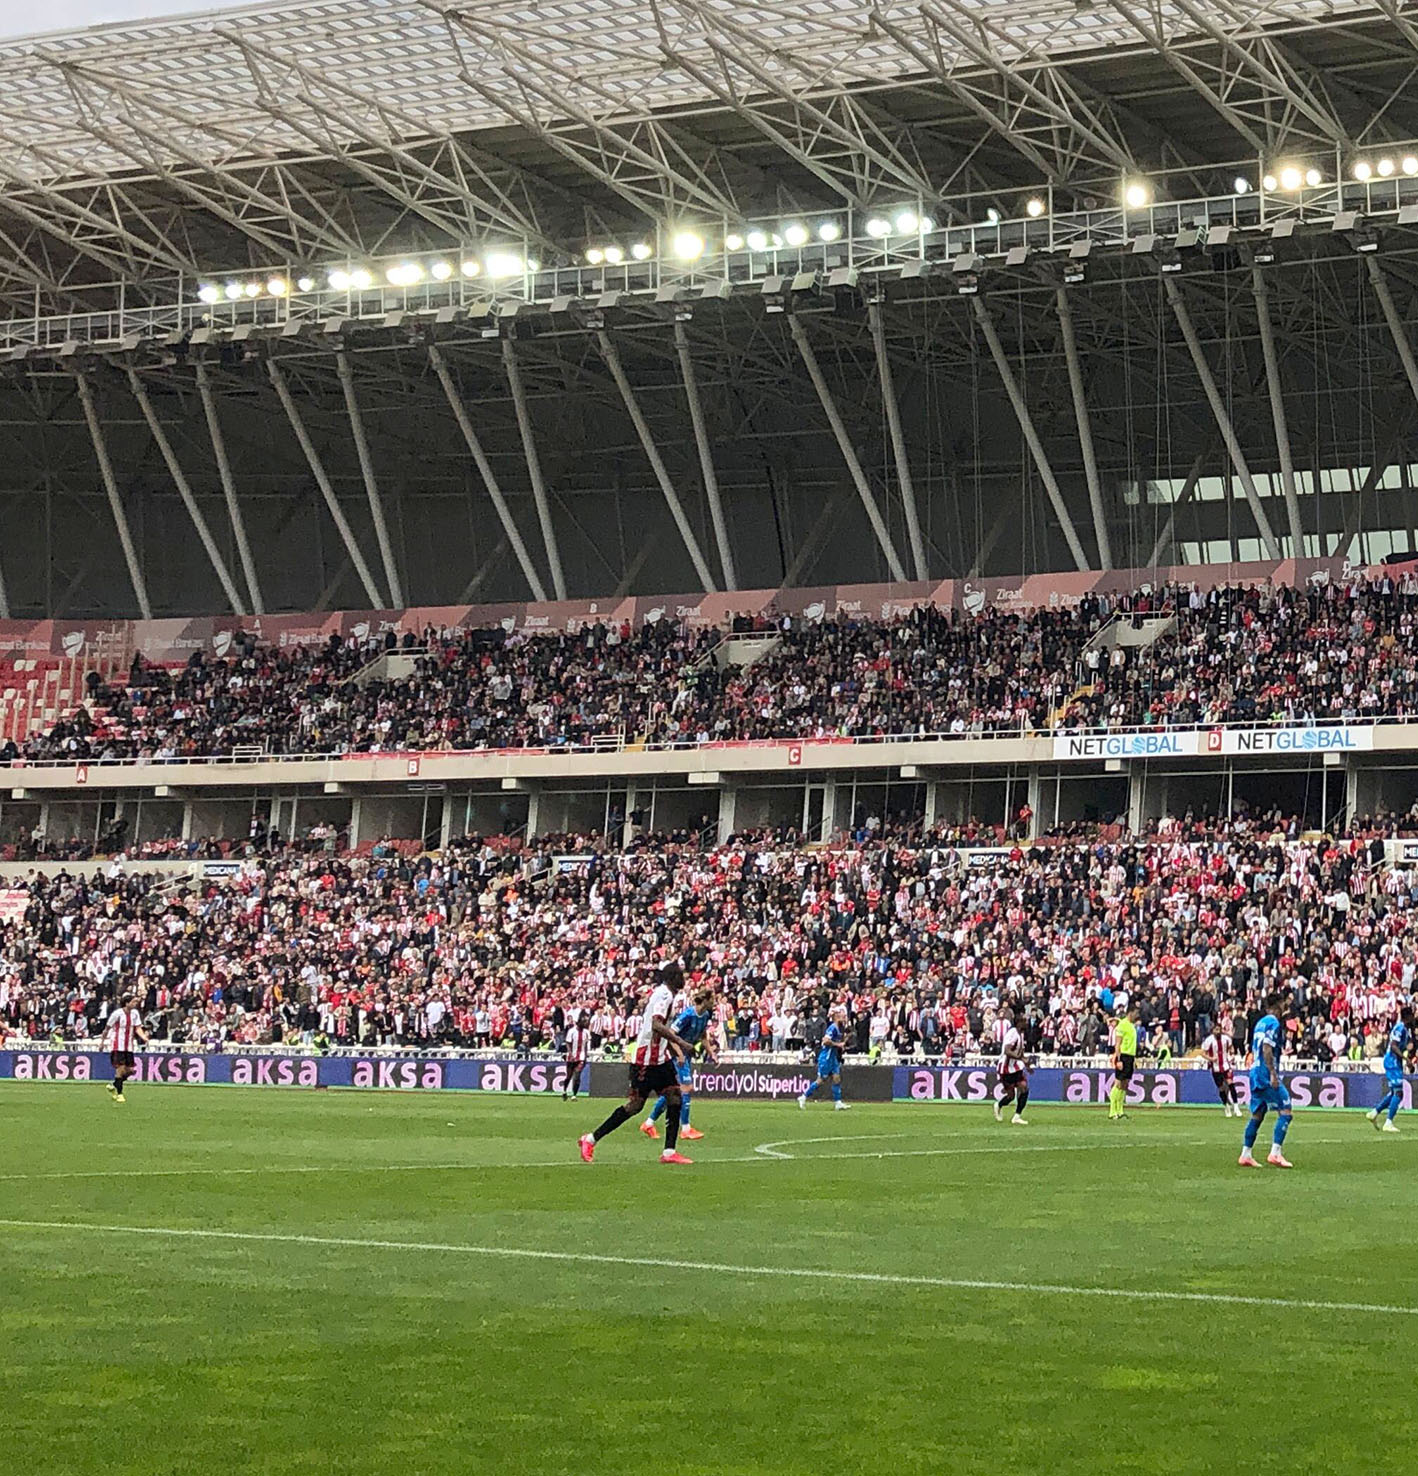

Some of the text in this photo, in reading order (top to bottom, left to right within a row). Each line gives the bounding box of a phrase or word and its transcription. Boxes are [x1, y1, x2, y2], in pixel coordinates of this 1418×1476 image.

[996, 588, 1023, 600] Ziraat
[1069, 733, 1183, 756] NETGLOBAL
[1209, 732, 1220, 748] D
[1238, 728, 1357, 751] NETGLOBAL
[408, 760, 418, 773] B
[789, 749, 800, 763] C
[77, 769, 86, 782] A
[14, 1054, 91, 1081] aksa
[232, 1058, 318, 1086] aksa
[353, 1061, 443, 1089] aksa
[481, 1064, 567, 1093] aksa
[692, 1069, 758, 1095] trendyol
[1233, 1074, 1345, 1108] asa
